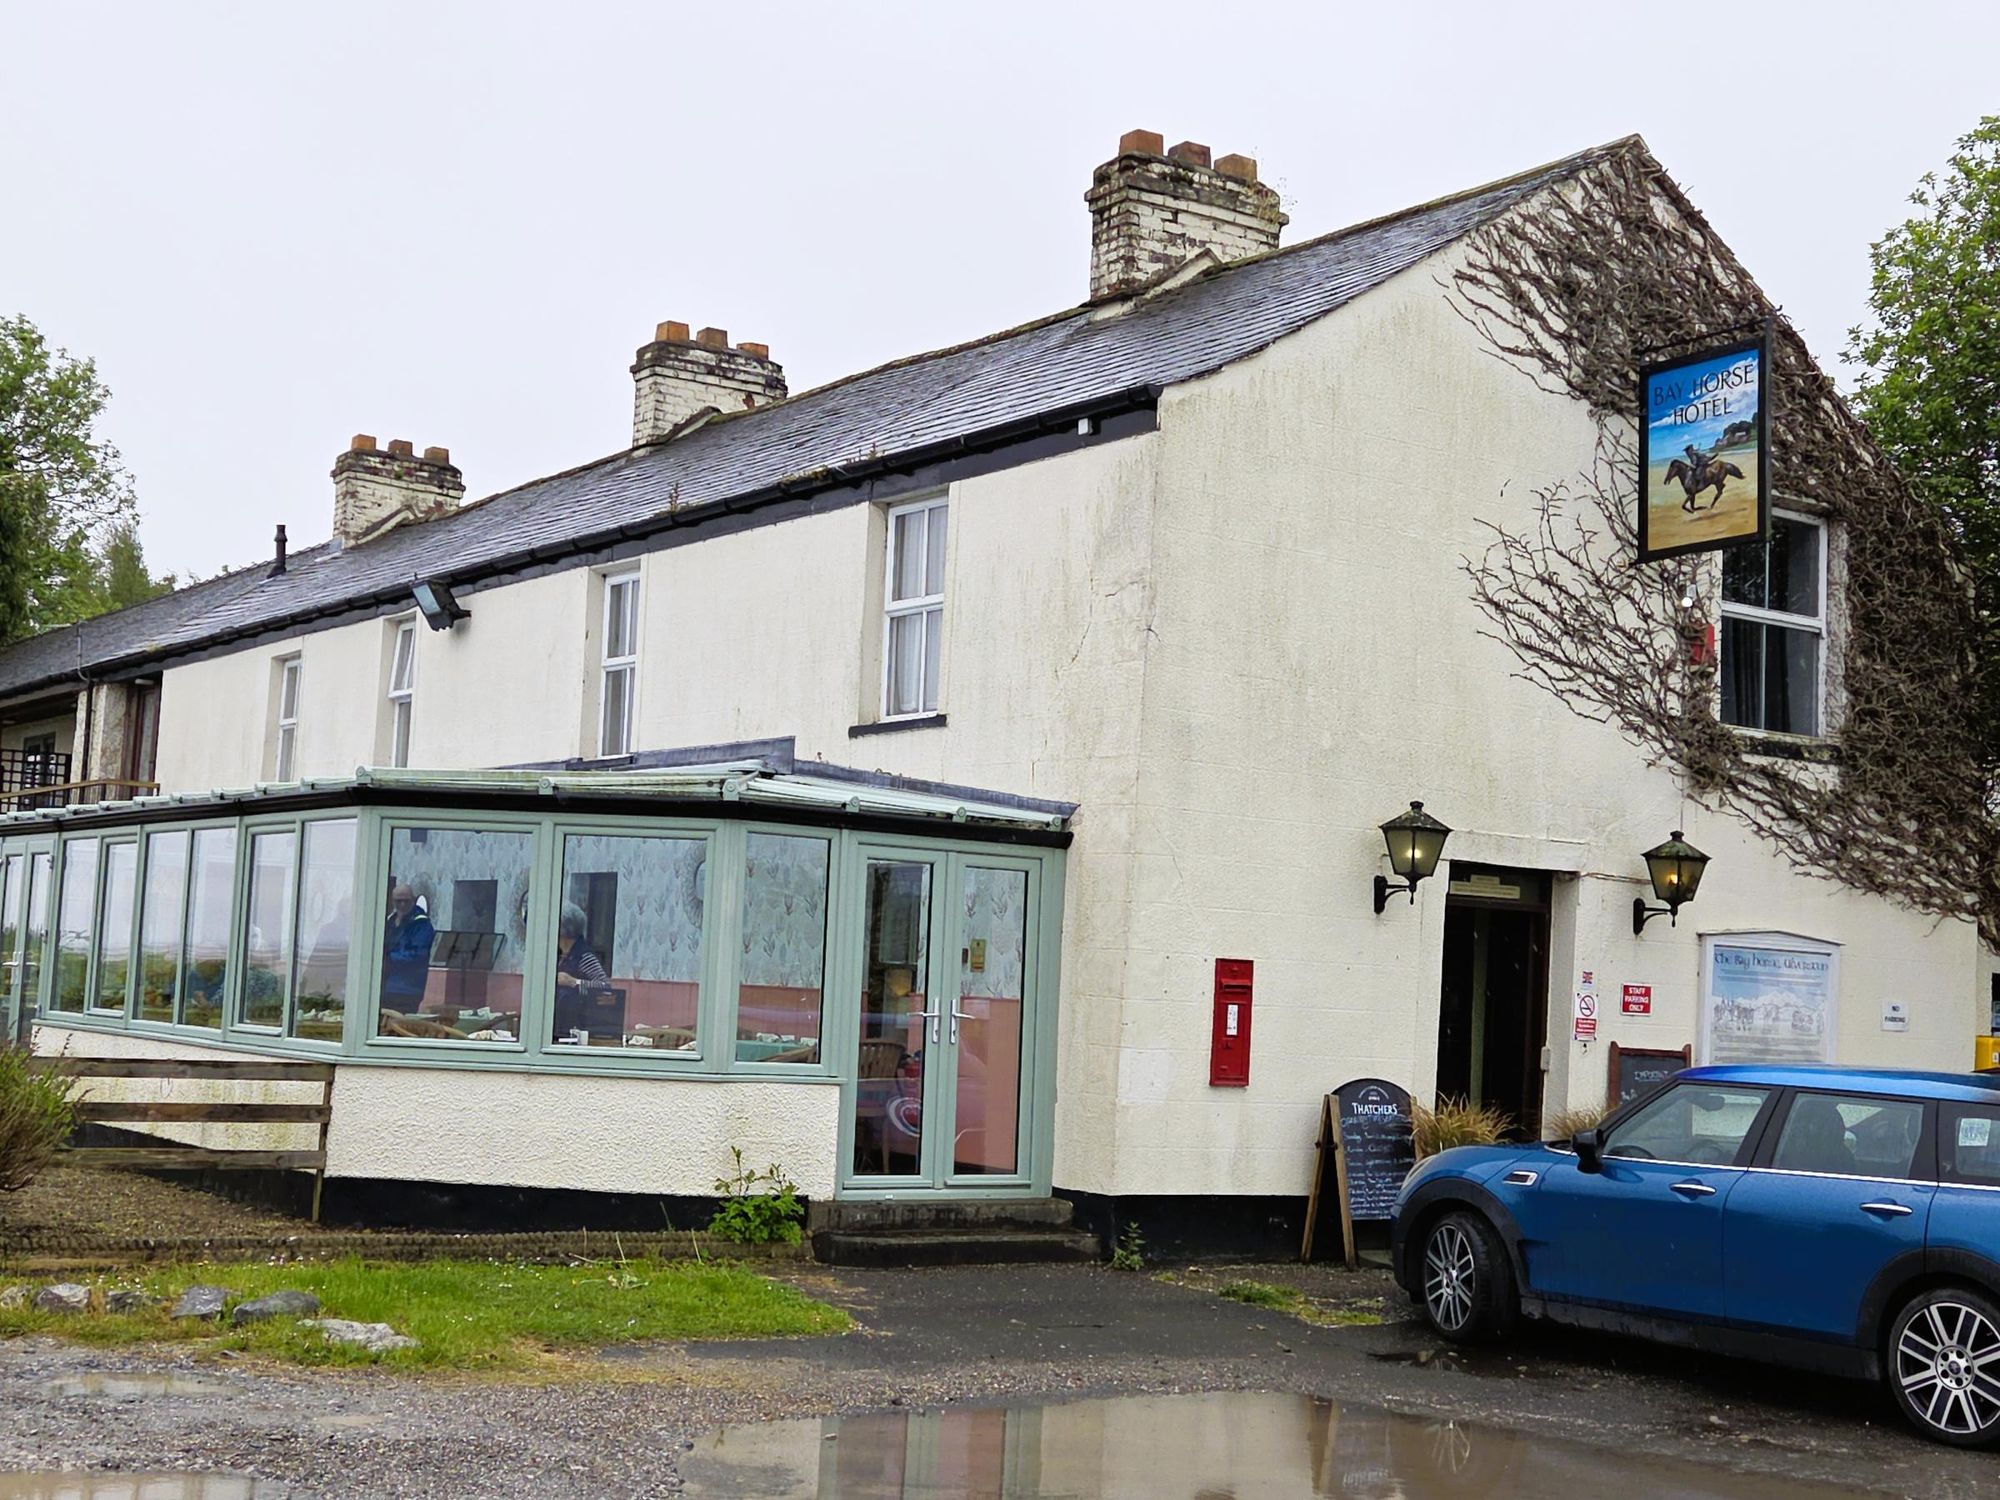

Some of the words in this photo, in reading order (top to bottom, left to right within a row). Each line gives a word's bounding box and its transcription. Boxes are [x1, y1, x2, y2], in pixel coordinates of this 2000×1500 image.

[1654, 383, 1684, 406] BAY
[1692, 364, 1754, 396] HORSE
[1673, 397, 1733, 426] HOTEL
[1624, 995, 1649, 1004] PARKING
[1628, 1004, 1645, 1012] ONLY
[1884, 1015, 1906, 1023] PARKING
[1352, 1102, 1398, 1115] THATCHERS
